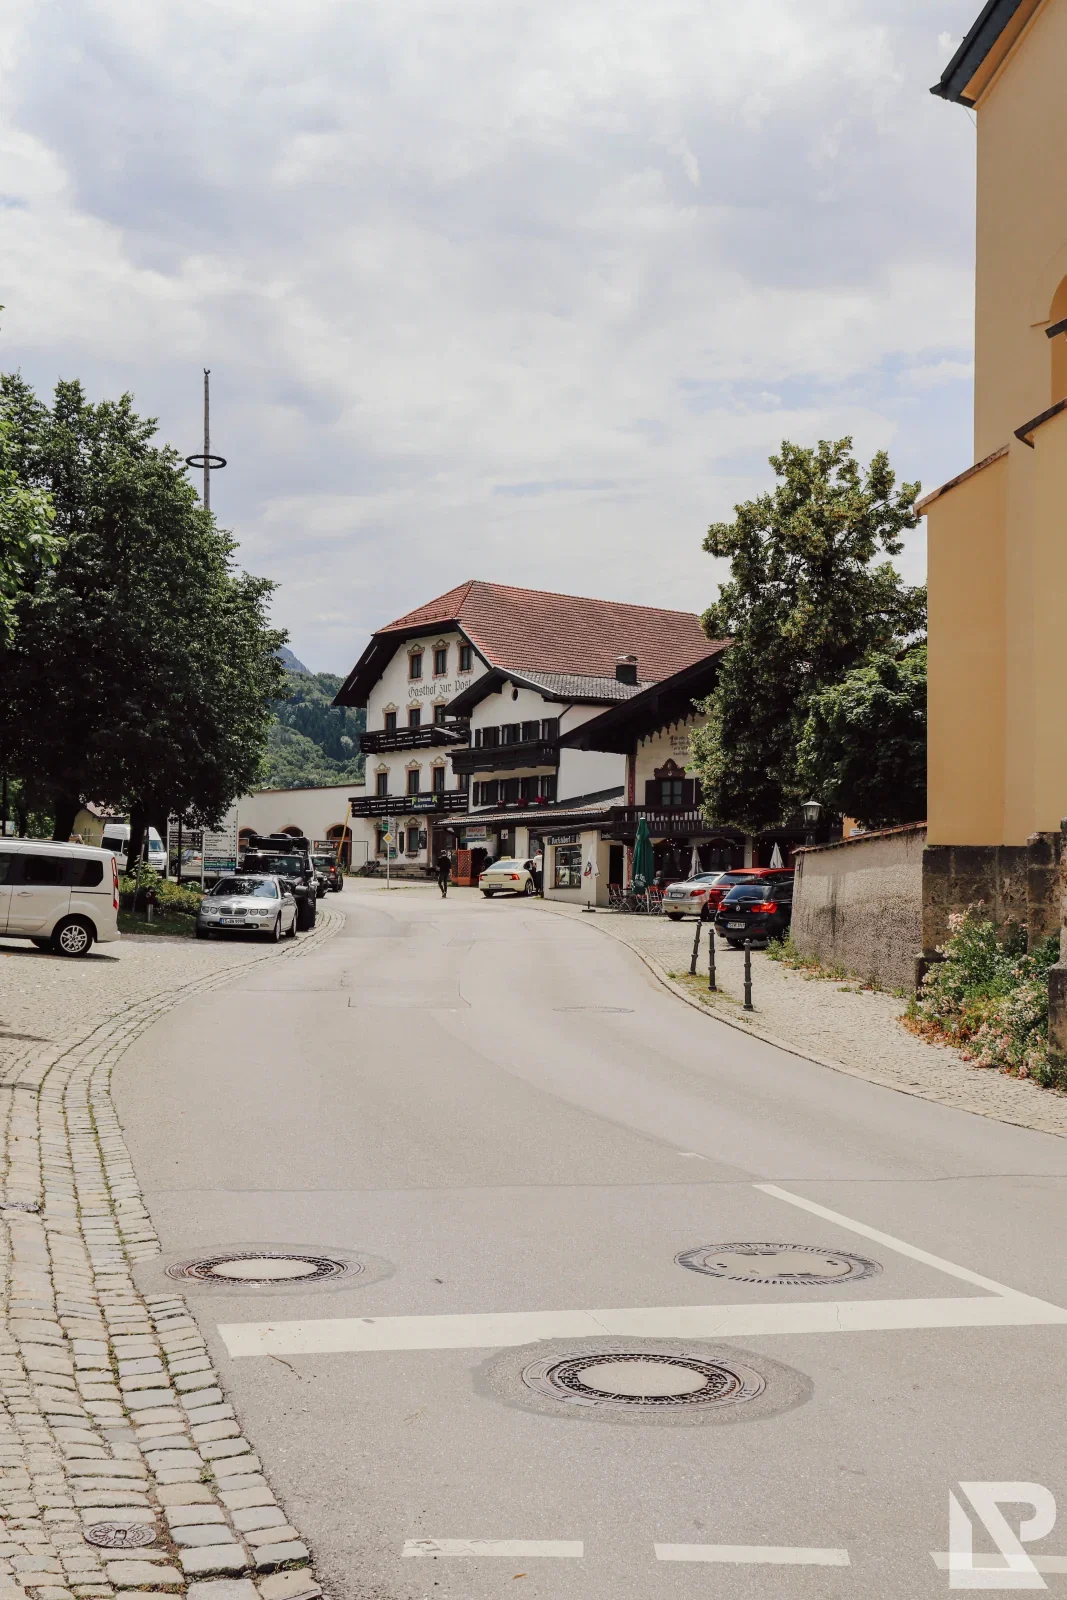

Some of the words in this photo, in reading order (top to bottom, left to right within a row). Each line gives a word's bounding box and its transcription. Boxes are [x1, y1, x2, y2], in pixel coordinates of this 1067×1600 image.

[408, 682, 437, 698] Gasthof
[439, 683, 452, 694] zur
[454, 679, 472, 693] Post
